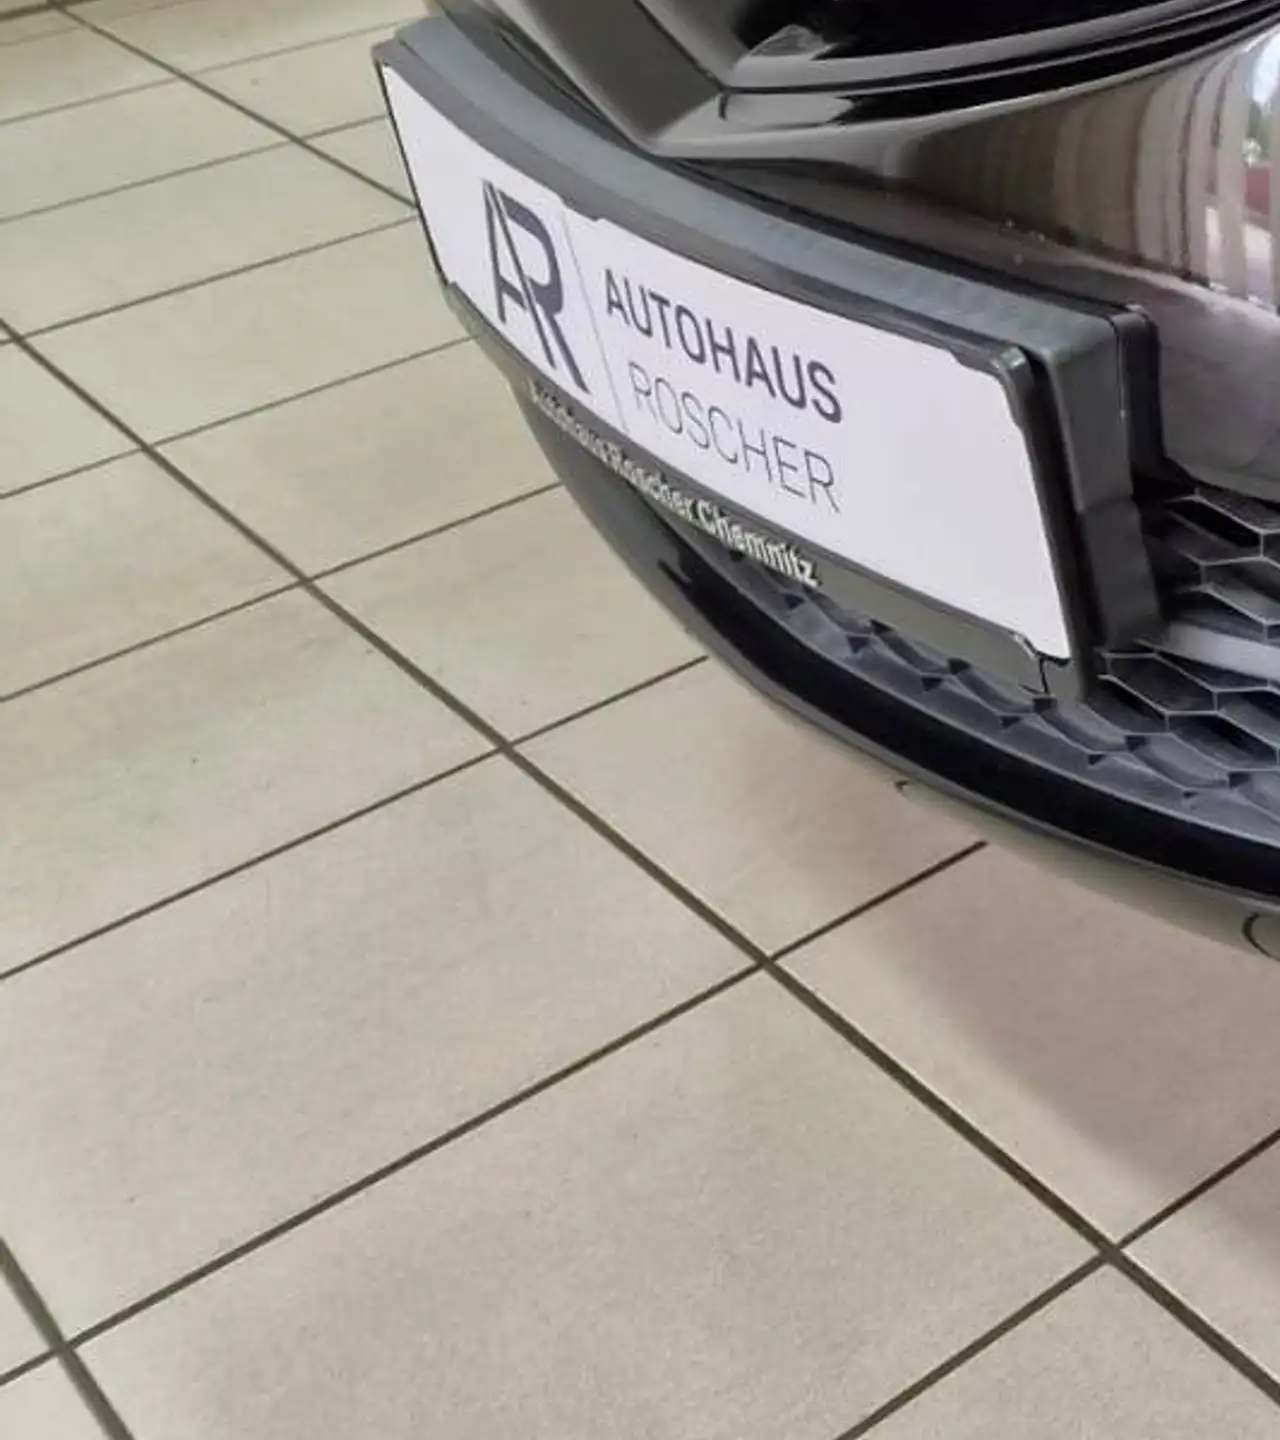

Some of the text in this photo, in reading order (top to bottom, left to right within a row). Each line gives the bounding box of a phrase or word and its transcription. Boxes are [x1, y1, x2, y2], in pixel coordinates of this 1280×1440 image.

[603, 268, 844, 424] AUTOHAUS
[629, 361, 841, 514] ROSCHER
[697, 503, 820, 588] Chemnitz
